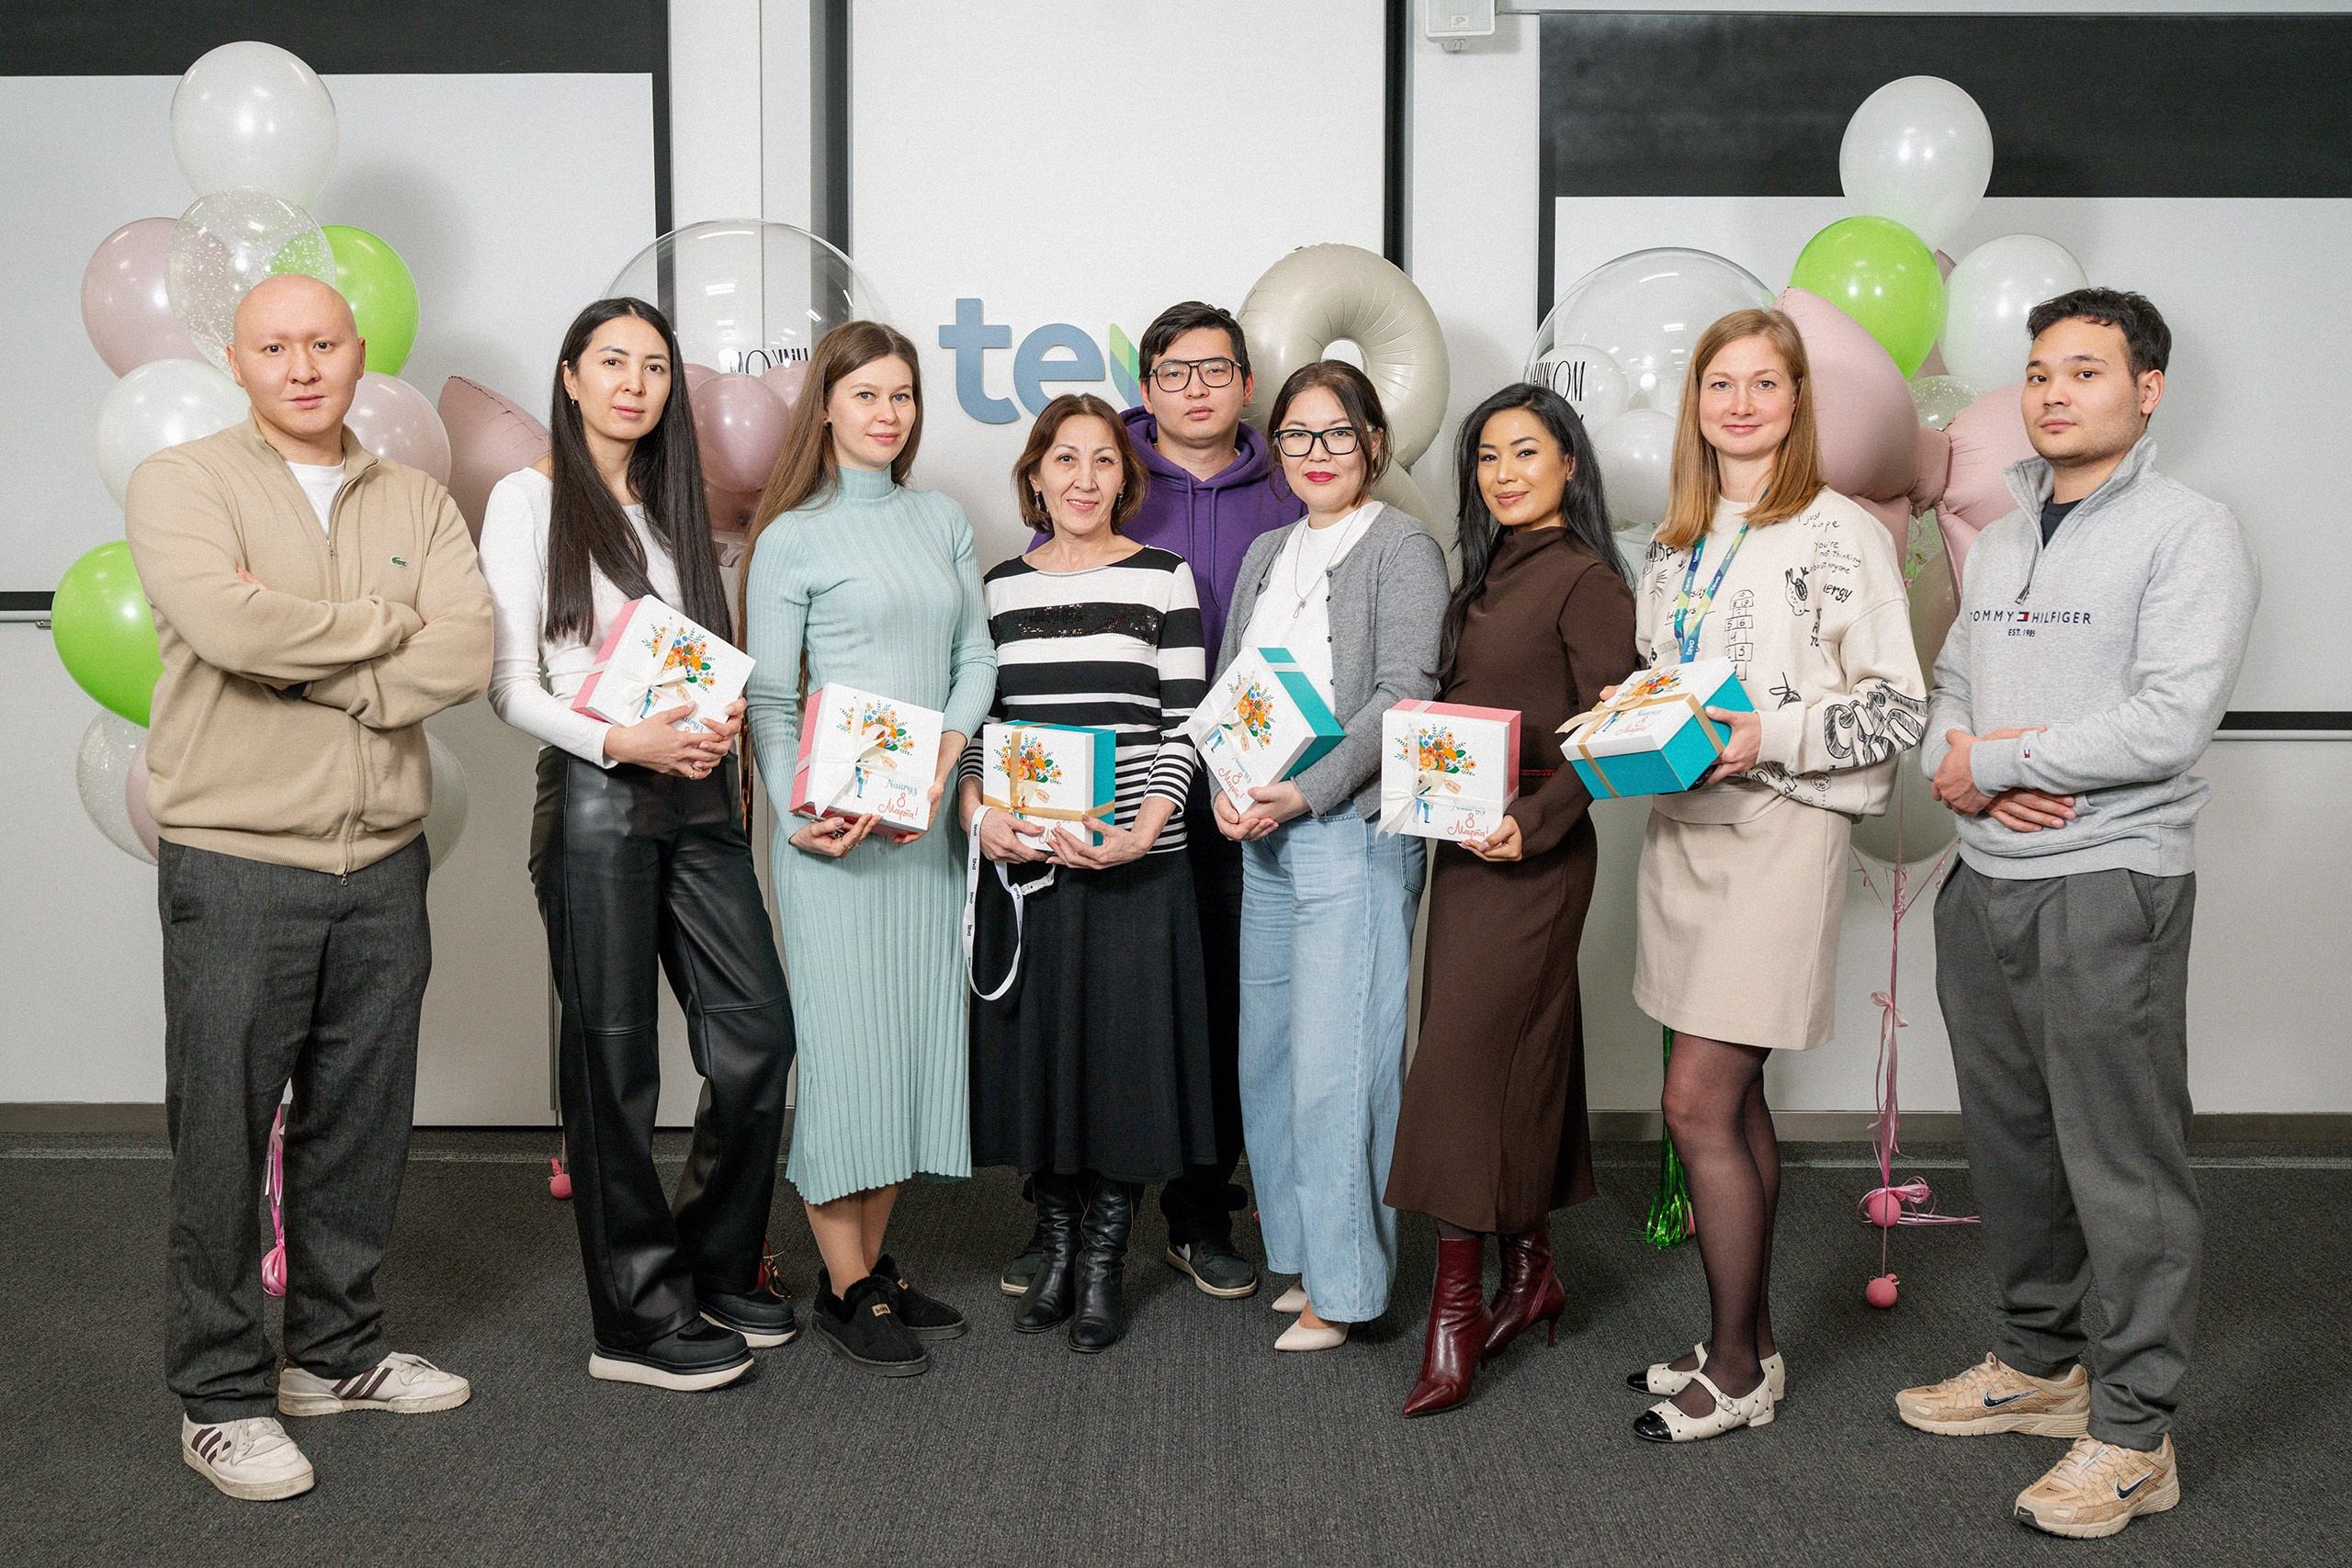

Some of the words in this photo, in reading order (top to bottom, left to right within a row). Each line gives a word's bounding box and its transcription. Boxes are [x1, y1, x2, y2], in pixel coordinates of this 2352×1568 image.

[1811, 520, 1840, 533] hope
[2031, 611, 2092, 625] HILFIGER
[1685, 639, 1695, 656] teva
[1737, 645, 1746, 657] 3
[1231, 772, 1244, 785] 8
[897, 792, 907, 808] 8
[877, 797, 920, 820] Марта!
[1464, 812, 1476, 829] 8
